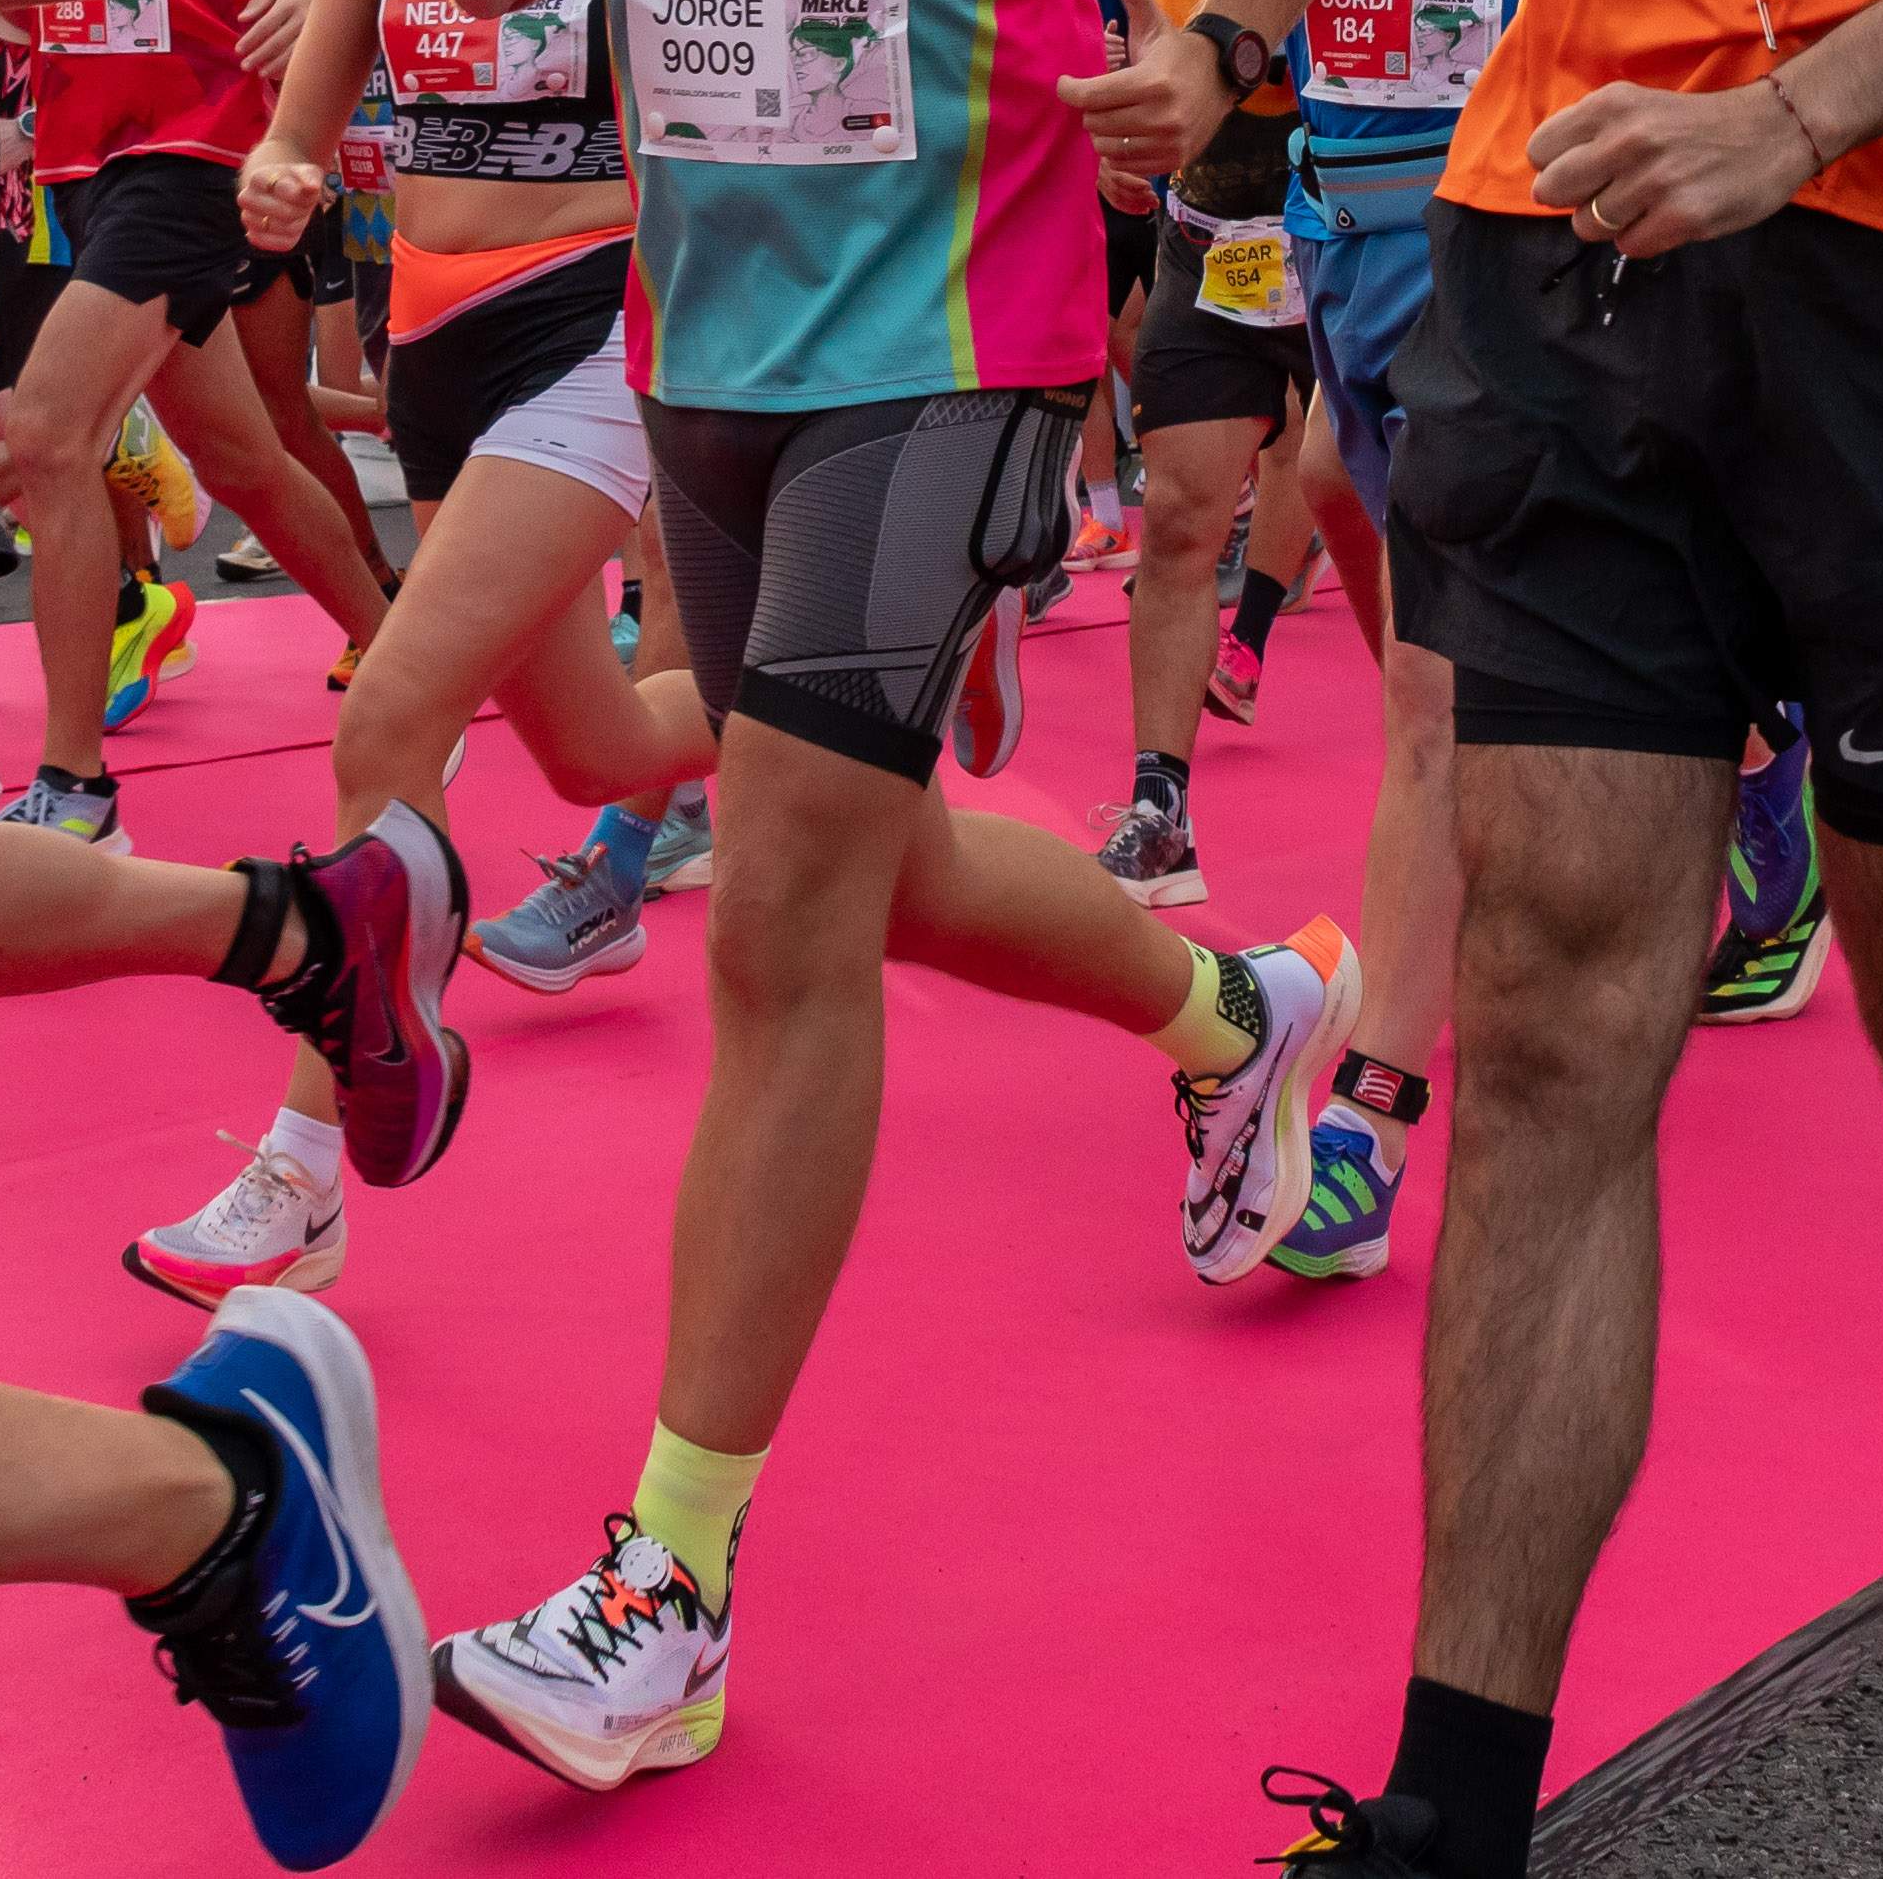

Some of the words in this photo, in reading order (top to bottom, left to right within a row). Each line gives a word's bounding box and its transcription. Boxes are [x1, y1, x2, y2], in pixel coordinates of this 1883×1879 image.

[56, 1, 85, 20] 288
[1332, 17, 1376, 44] 184
[416, 31, 465, 59] 447
[662, 39, 755, 75] 9009
[823, 144, 853, 155] 9009
[1226, 268, 1262, 287] 654
[566, 907, 617, 948] HOKA
